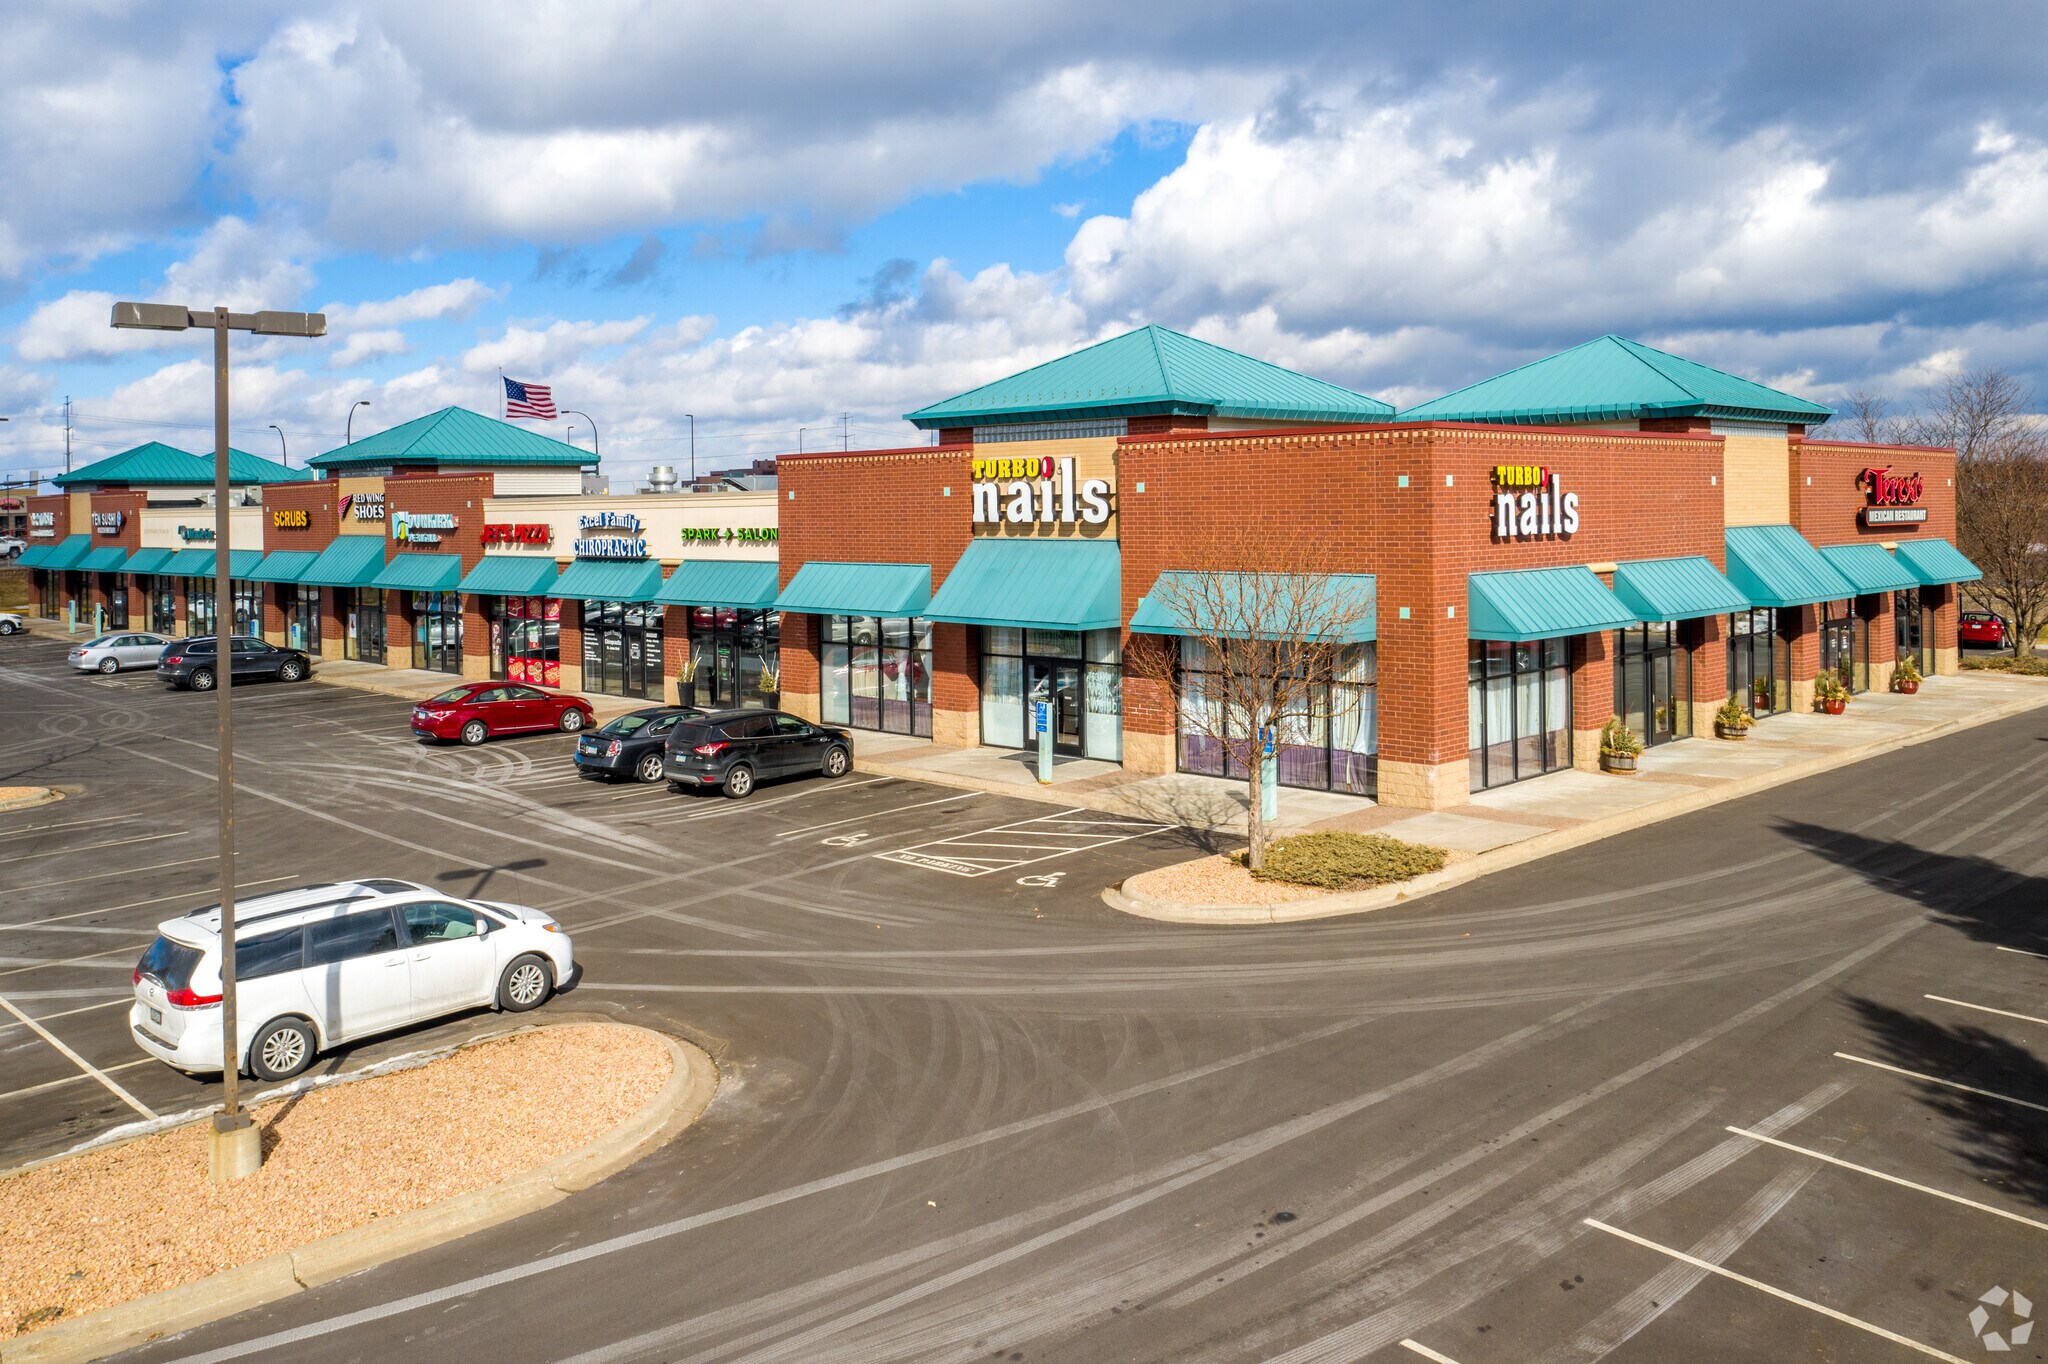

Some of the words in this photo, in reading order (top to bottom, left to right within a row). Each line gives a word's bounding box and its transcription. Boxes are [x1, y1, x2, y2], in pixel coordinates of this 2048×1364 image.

[972, 457, 1039, 479] TURBO
[1497, 465, 1541, 486] TURBO
[972, 456, 1109, 524] nails
[1864, 466, 1924, 505] Teresa's
[353, 493, 365, 503] RED
[366, 492, 385, 503] WING
[1497, 466, 1579, 537] nails
[101, 512, 117, 526] SUSHI
[273, 510, 307, 528] SCRUBS
[354, 504, 385, 519] SHOES
[1868, 510, 1894, 522] MEXICAN
[1895, 509, 1926, 522] RESTAURANT
[578, 511, 602, 530] Excel
[605, 511, 639, 533] Family
[513, 523, 549, 545] PIZZA
[680, 527, 718, 541] SPARK
[737, 527, 779, 541] SALON
[573, 538, 645, 557] CHIROPRACTIC
